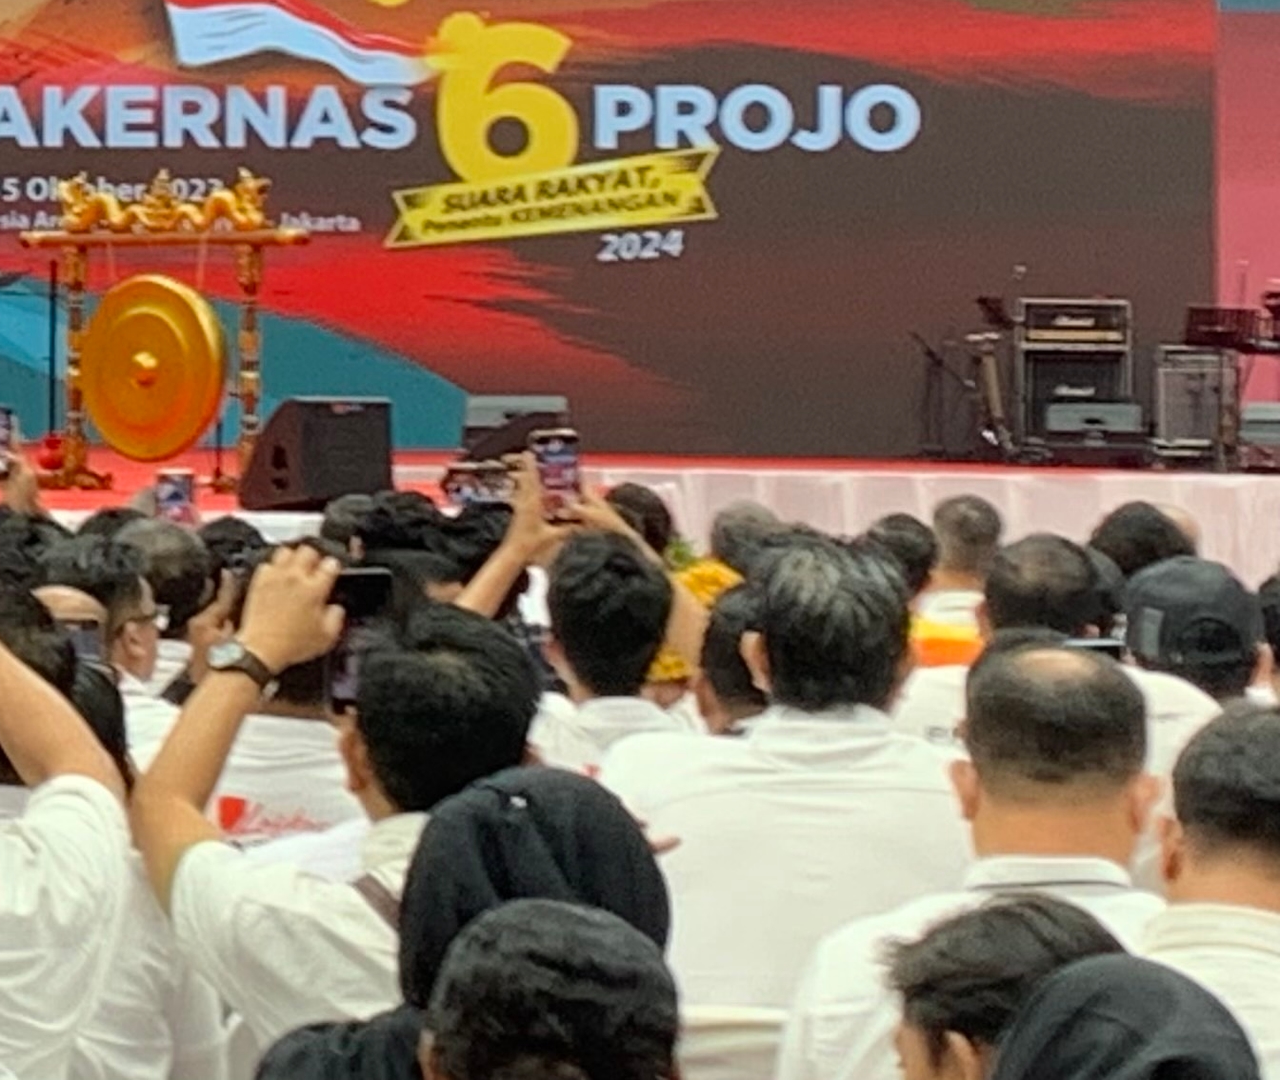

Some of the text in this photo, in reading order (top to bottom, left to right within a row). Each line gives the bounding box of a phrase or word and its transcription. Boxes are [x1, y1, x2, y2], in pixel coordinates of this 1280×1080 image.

[436, 11, 580, 186] 6
[593, 83, 921, 153] PROJO
[443, 182, 528, 213] SUARA
[596, 229, 685, 262] 2024
